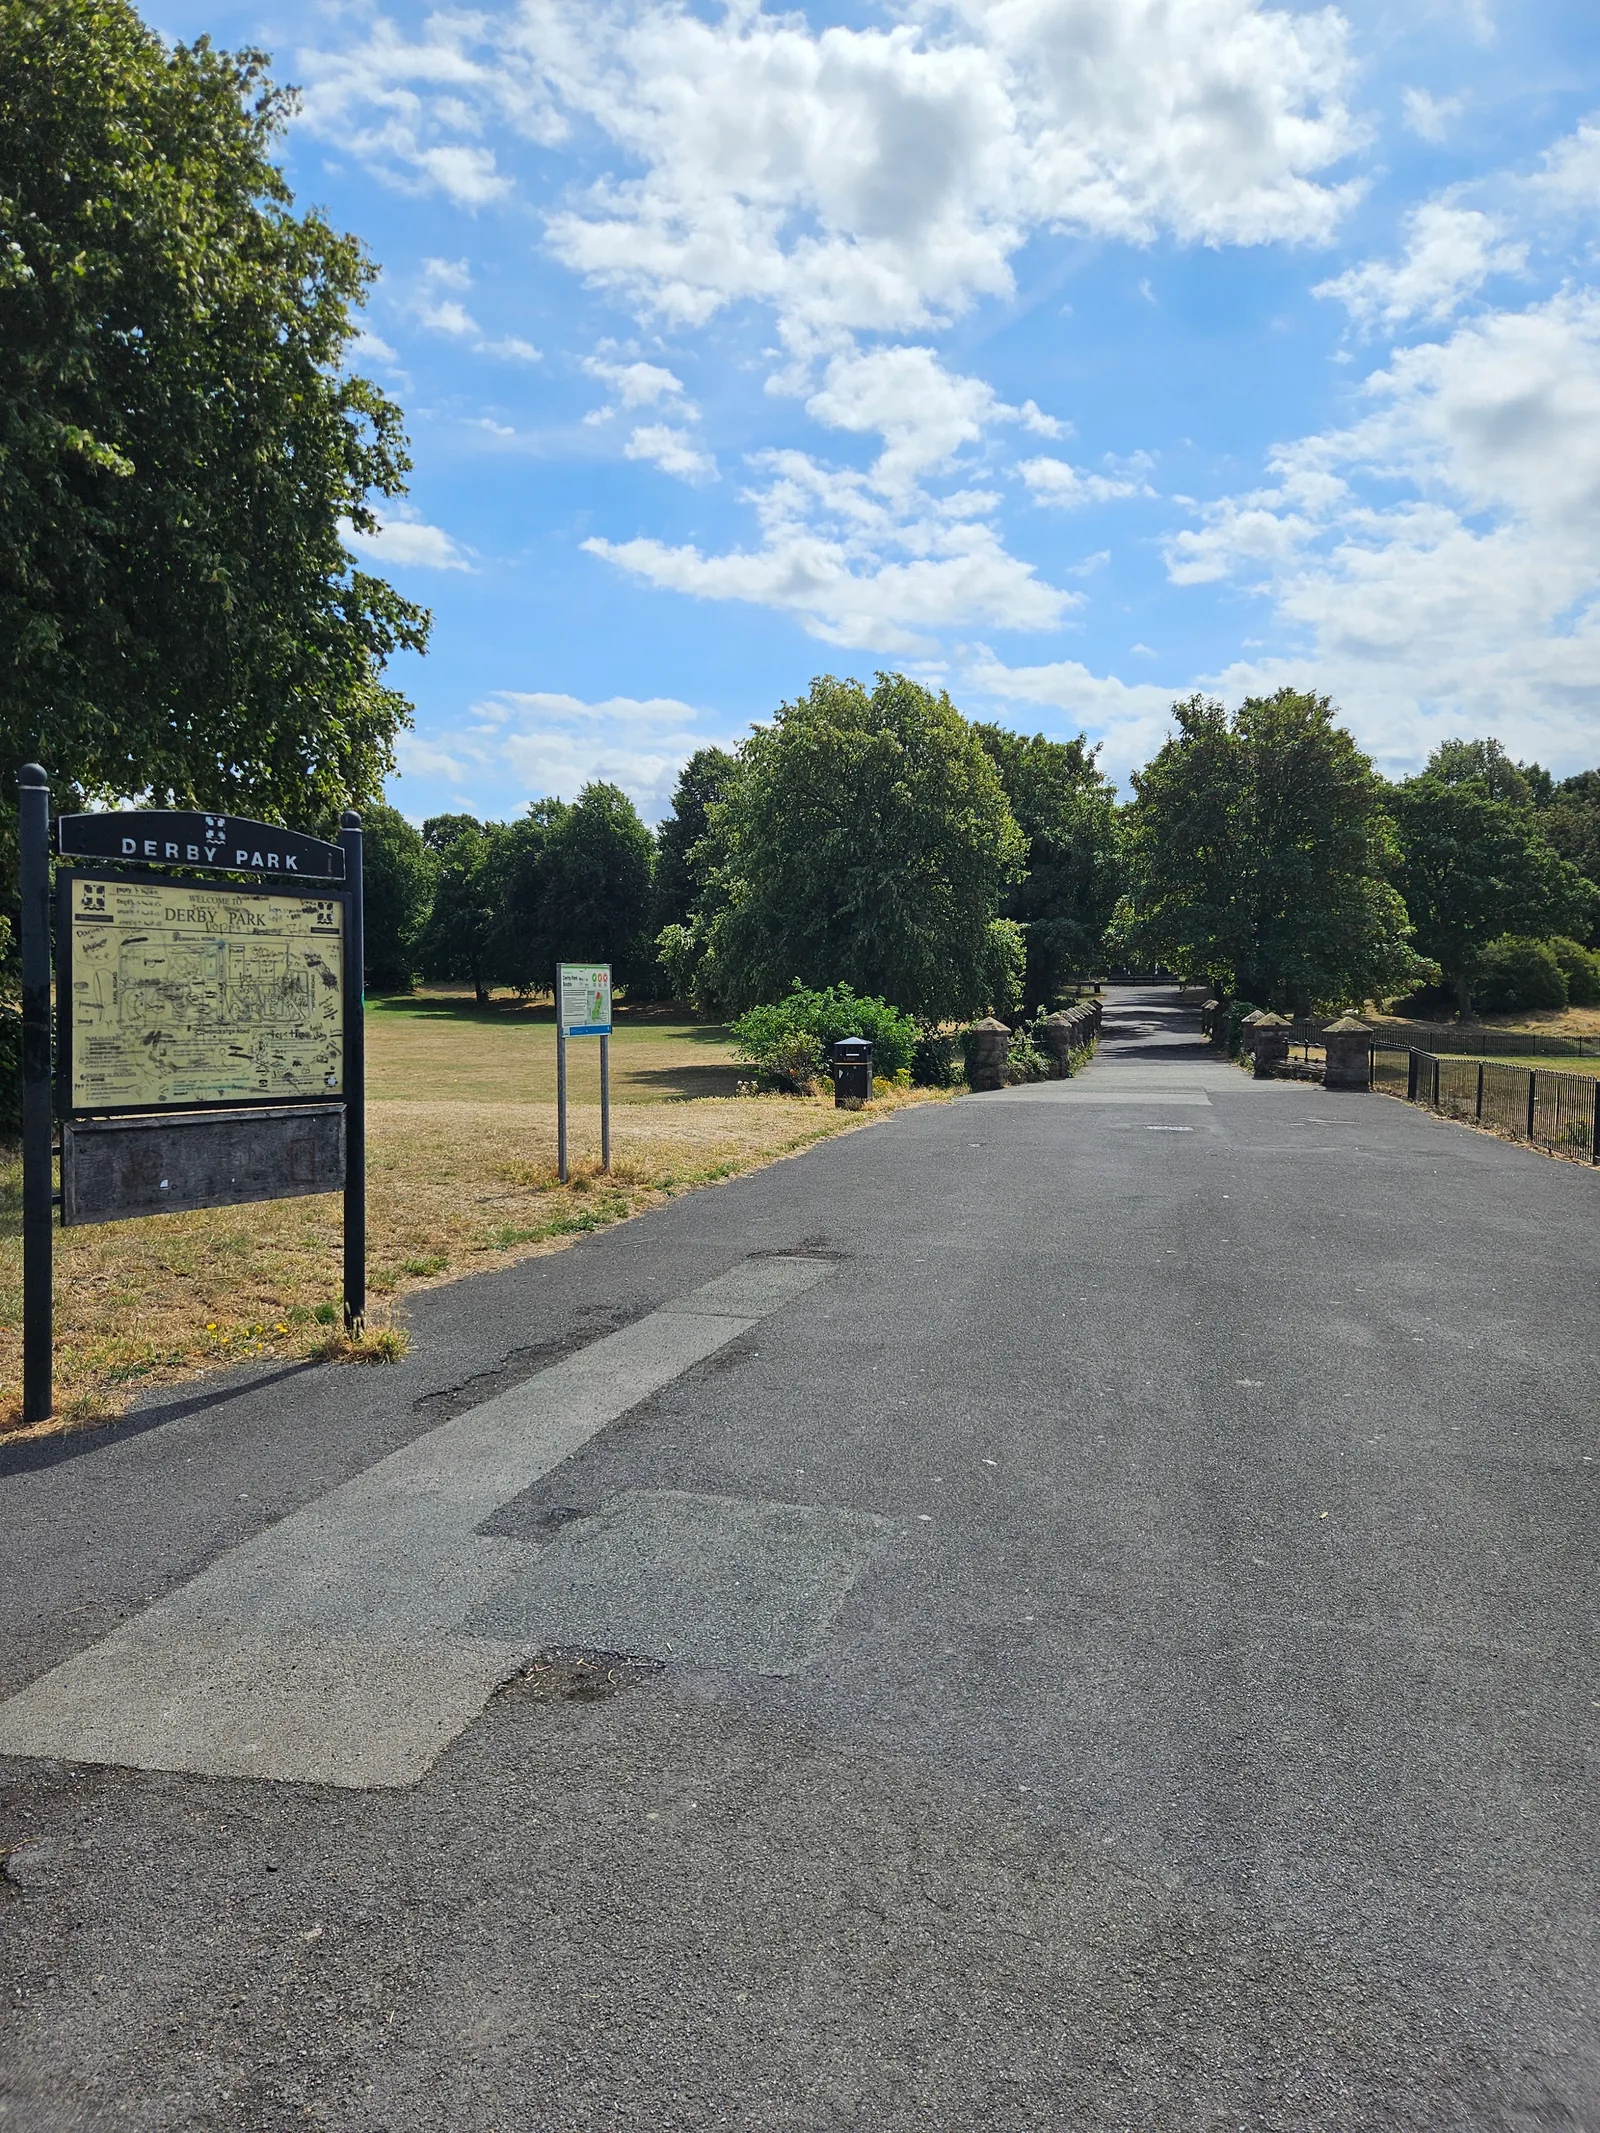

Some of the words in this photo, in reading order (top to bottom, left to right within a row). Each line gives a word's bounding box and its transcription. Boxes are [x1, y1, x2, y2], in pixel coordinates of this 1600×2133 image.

[121, 838, 217, 862] DERBY
[236, 850, 298, 870] PARK
[188, 894, 230, 905] WELCOME
[232, 897, 243, 906] TO
[164, 907, 218, 923] DERBY
[229, 911, 267, 927] PARK
